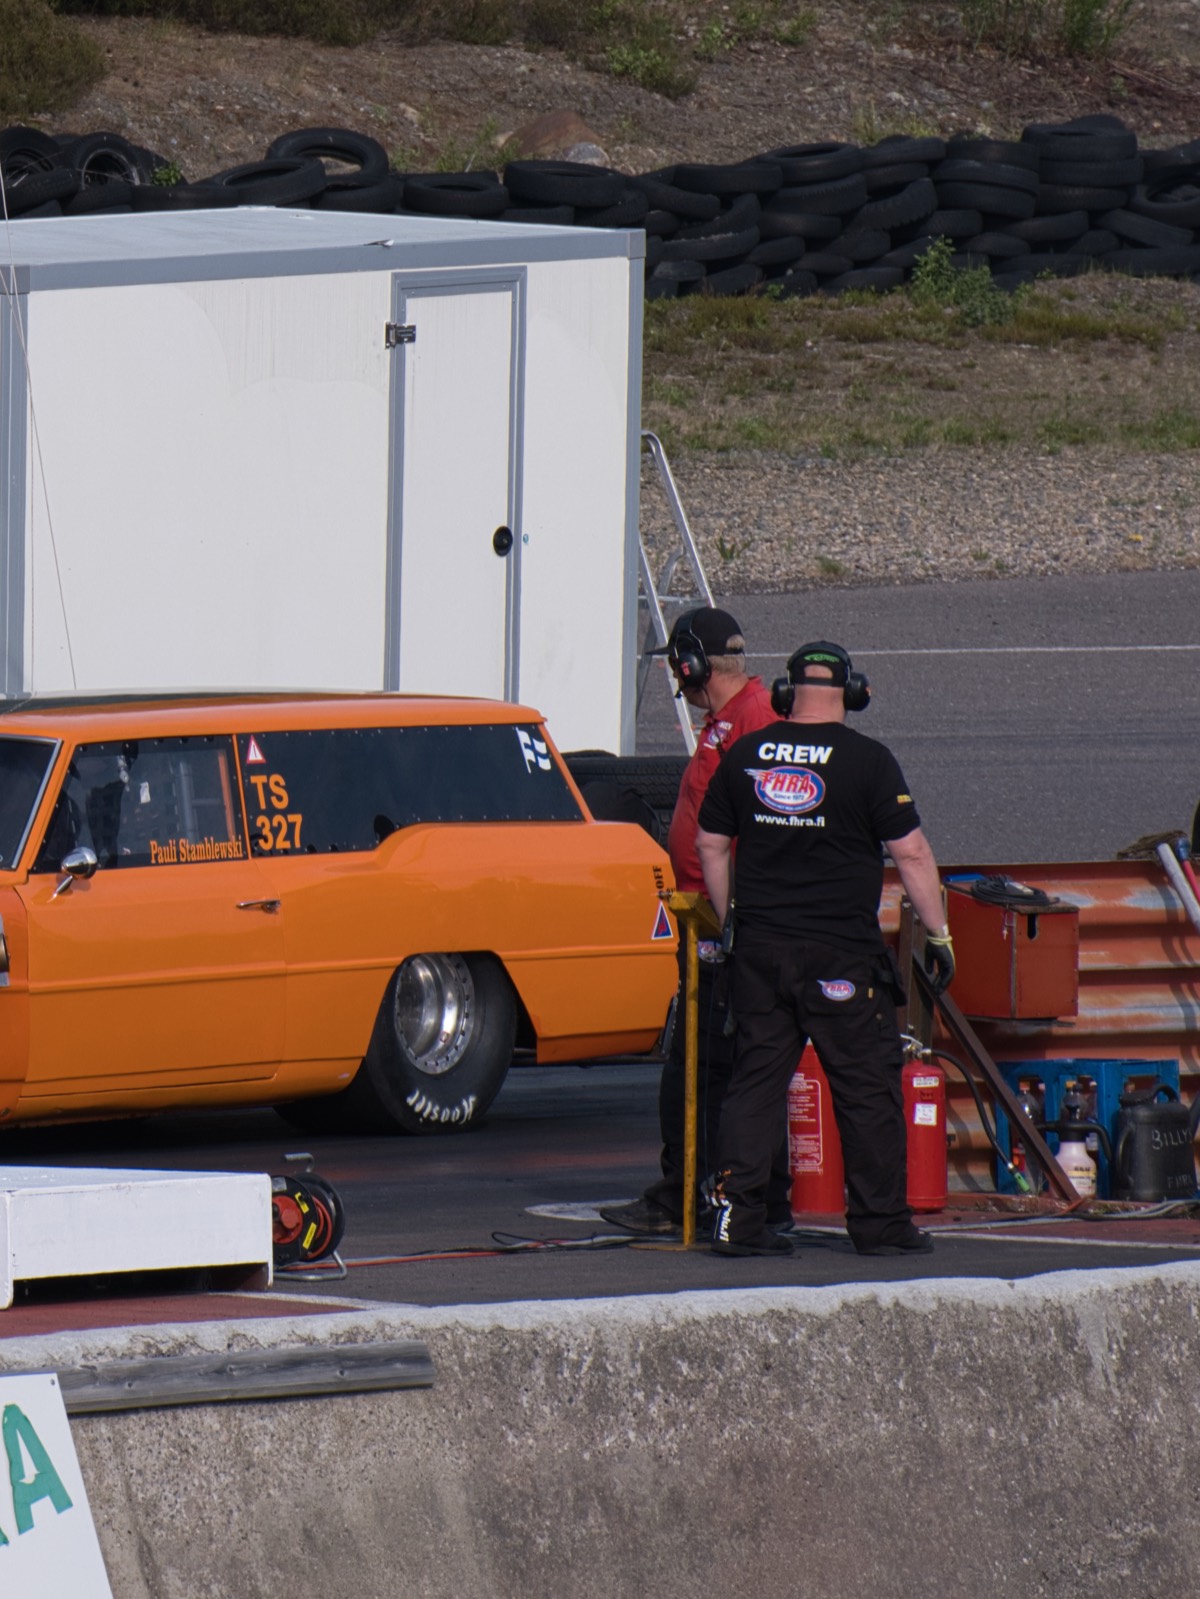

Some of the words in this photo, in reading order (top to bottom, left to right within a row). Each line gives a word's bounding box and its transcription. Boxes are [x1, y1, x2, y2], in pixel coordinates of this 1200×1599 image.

[758, 742, 833, 764] CREW
[250, 774, 289, 810] TS
[760, 771, 812, 794] FHRA
[256, 814, 302, 850] 327
[754, 813, 825, 827] www.fhra.fi
[150, 838, 177, 864] Pauli
[652, 865, 665, 890] OFF
[406, 1089, 477, 1125] Hoosier
